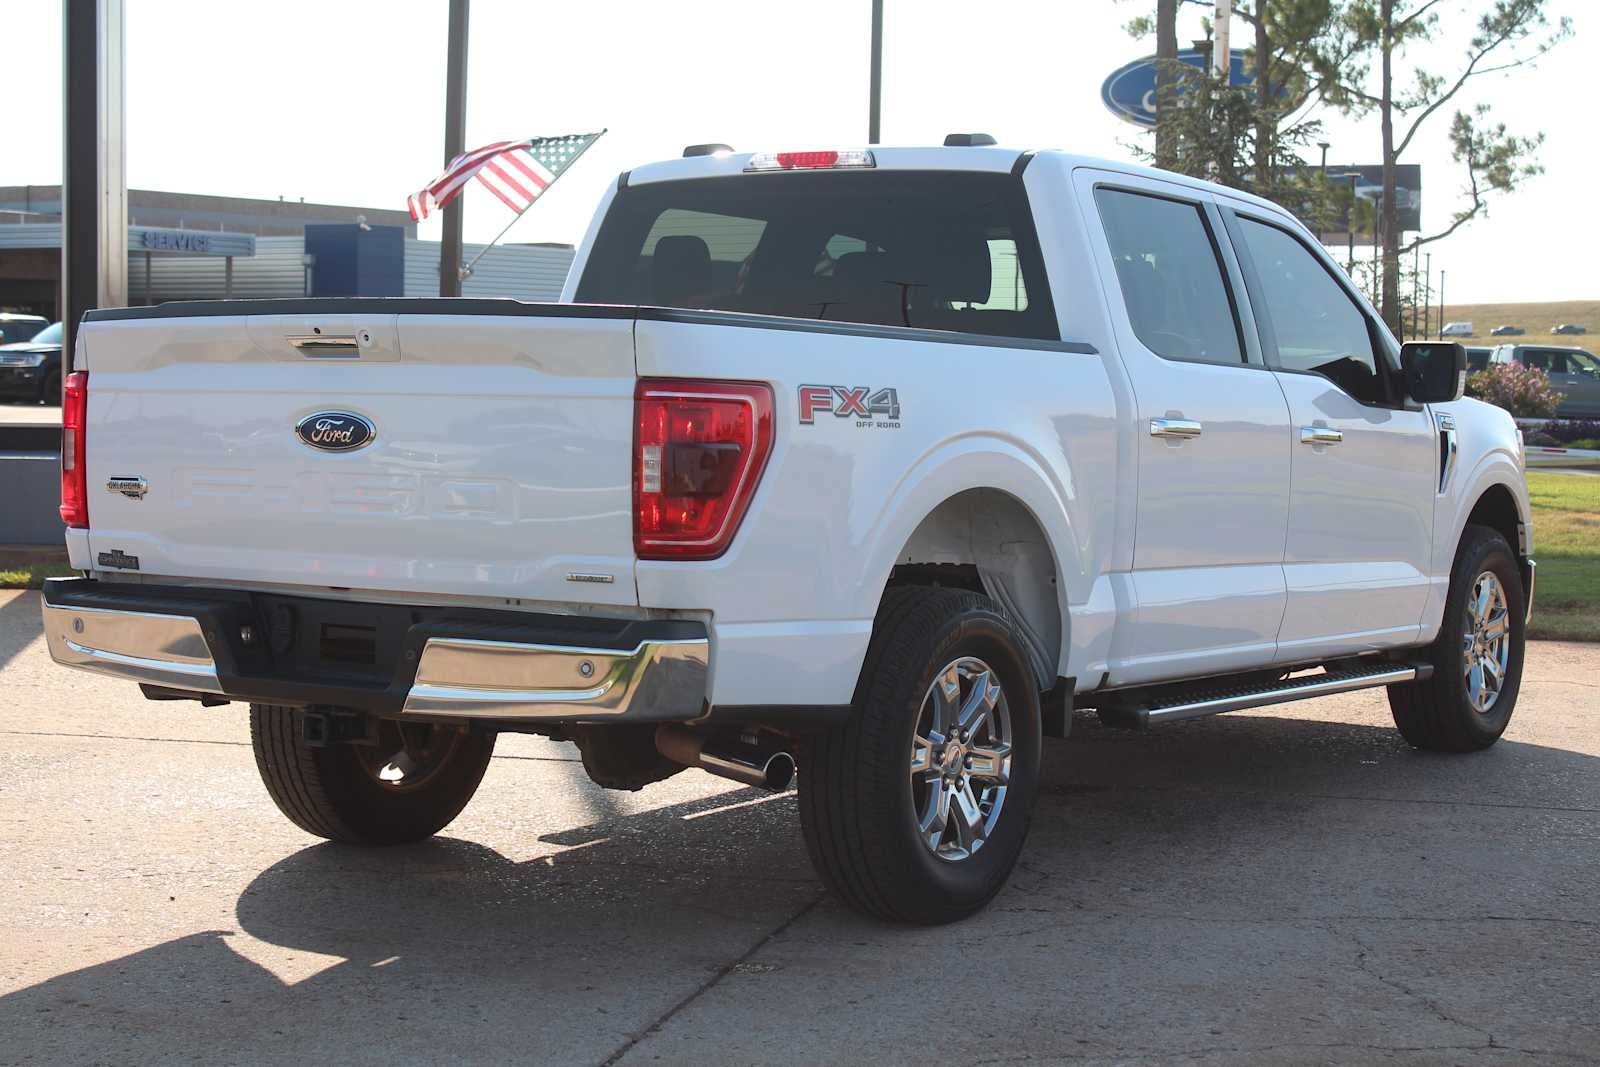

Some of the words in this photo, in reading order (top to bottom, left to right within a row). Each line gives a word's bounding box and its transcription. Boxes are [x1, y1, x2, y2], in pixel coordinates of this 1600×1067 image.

[143, 231, 209, 251] SERVICE
[797, 383, 901, 425] FX4
[311, 418, 355, 443] Ford
[855, 421, 873, 429] OFF
[876, 421, 901, 429] ROAD
